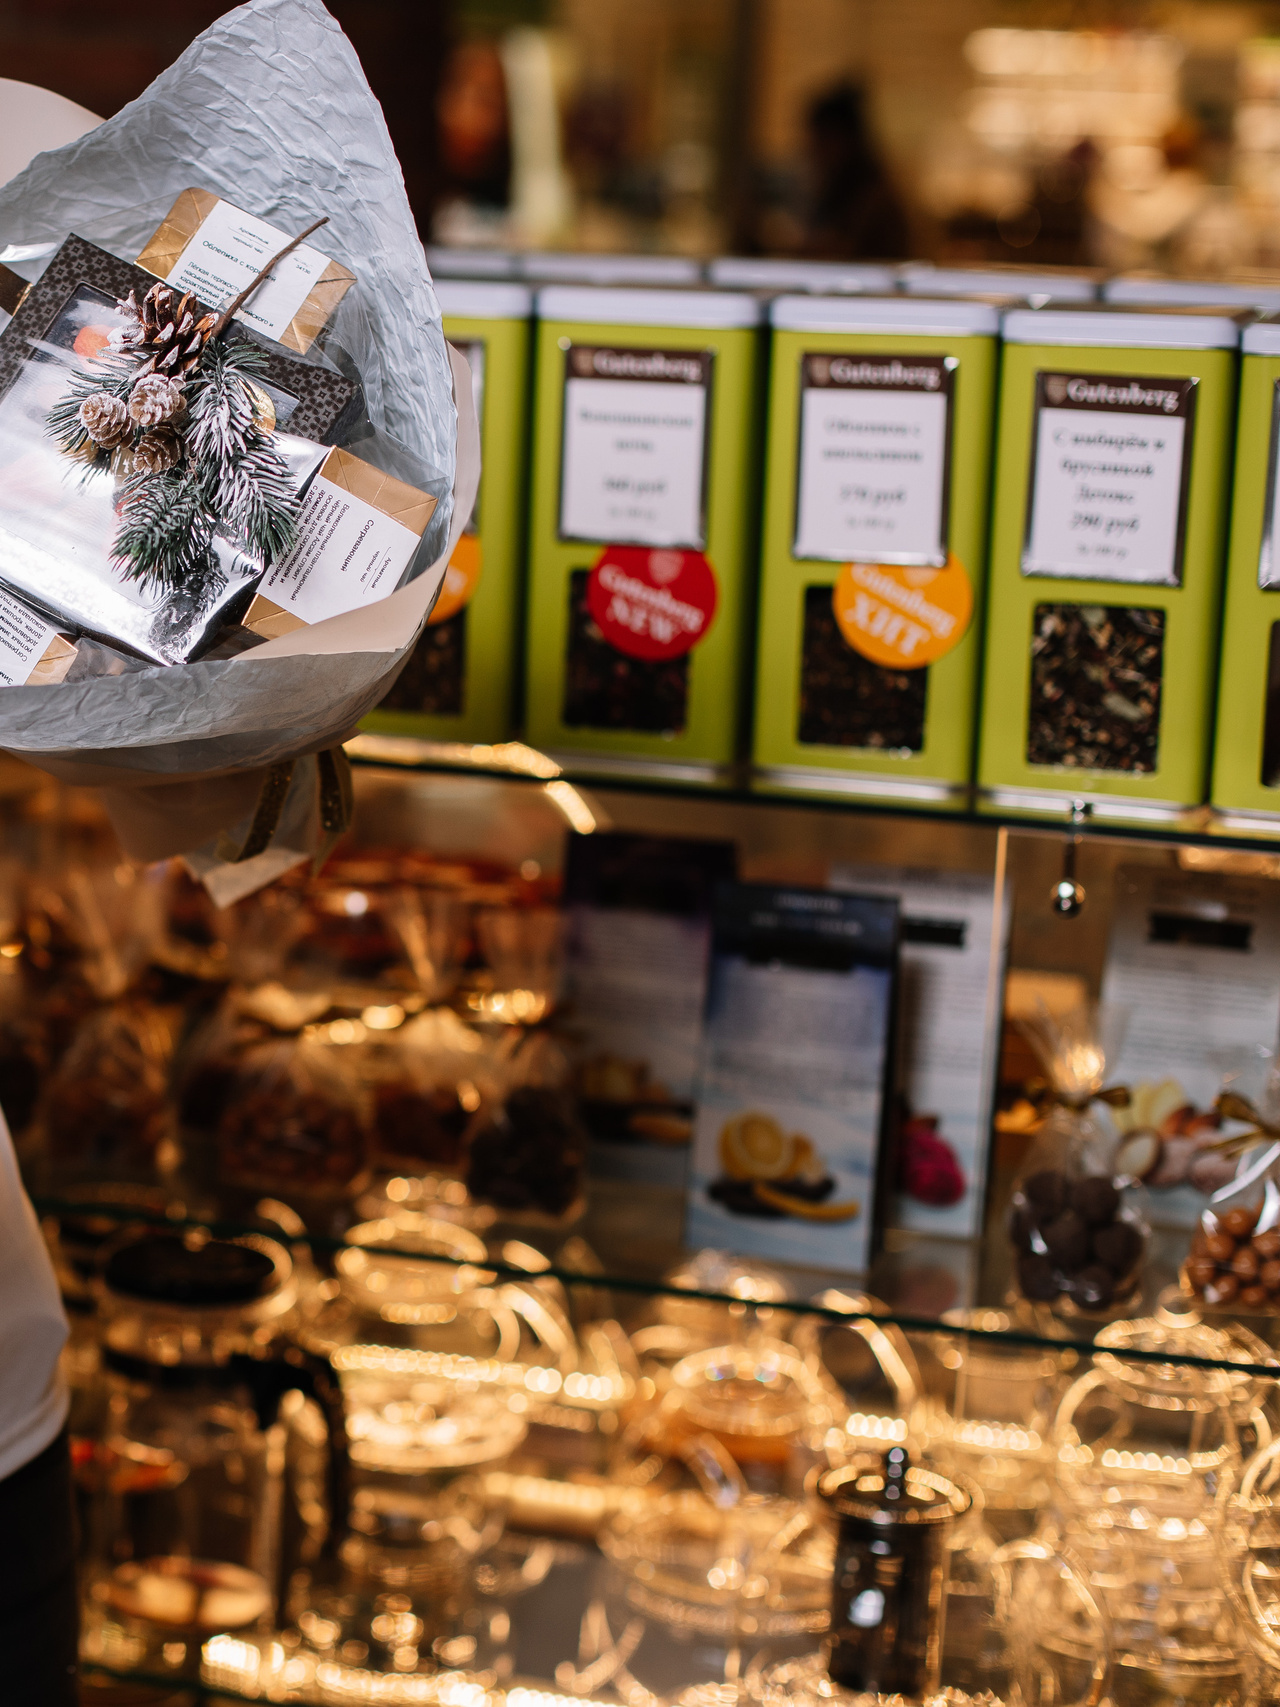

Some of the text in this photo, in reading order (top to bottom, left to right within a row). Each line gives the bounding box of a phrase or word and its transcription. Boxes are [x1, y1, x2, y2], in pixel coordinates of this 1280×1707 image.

[201, 239, 239, 263] Облепиха
[594, 351, 702, 383] Gutenberg
[830, 359, 940, 391] Gutenberg
[1067, 379, 1179, 413] Gutenberg
[300, 488, 326, 525] ароматной
[314, 493, 334, 521] основой
[306, 519, 318, 534] для
[316, 523, 328, 537] чай
[280, 533, 310, 578] согревающей
[289, 502, 349, 602] Великолепный плантационный
[304, 535, 320, 558] Ассам
[339, 517, 374, 572] Согревающий
[289, 556, 307, 581] служит
[1, 605, 24, 624] крошки
[17, 607, 47, 632] шоколада
[9, 634, 34, 654] уютных
